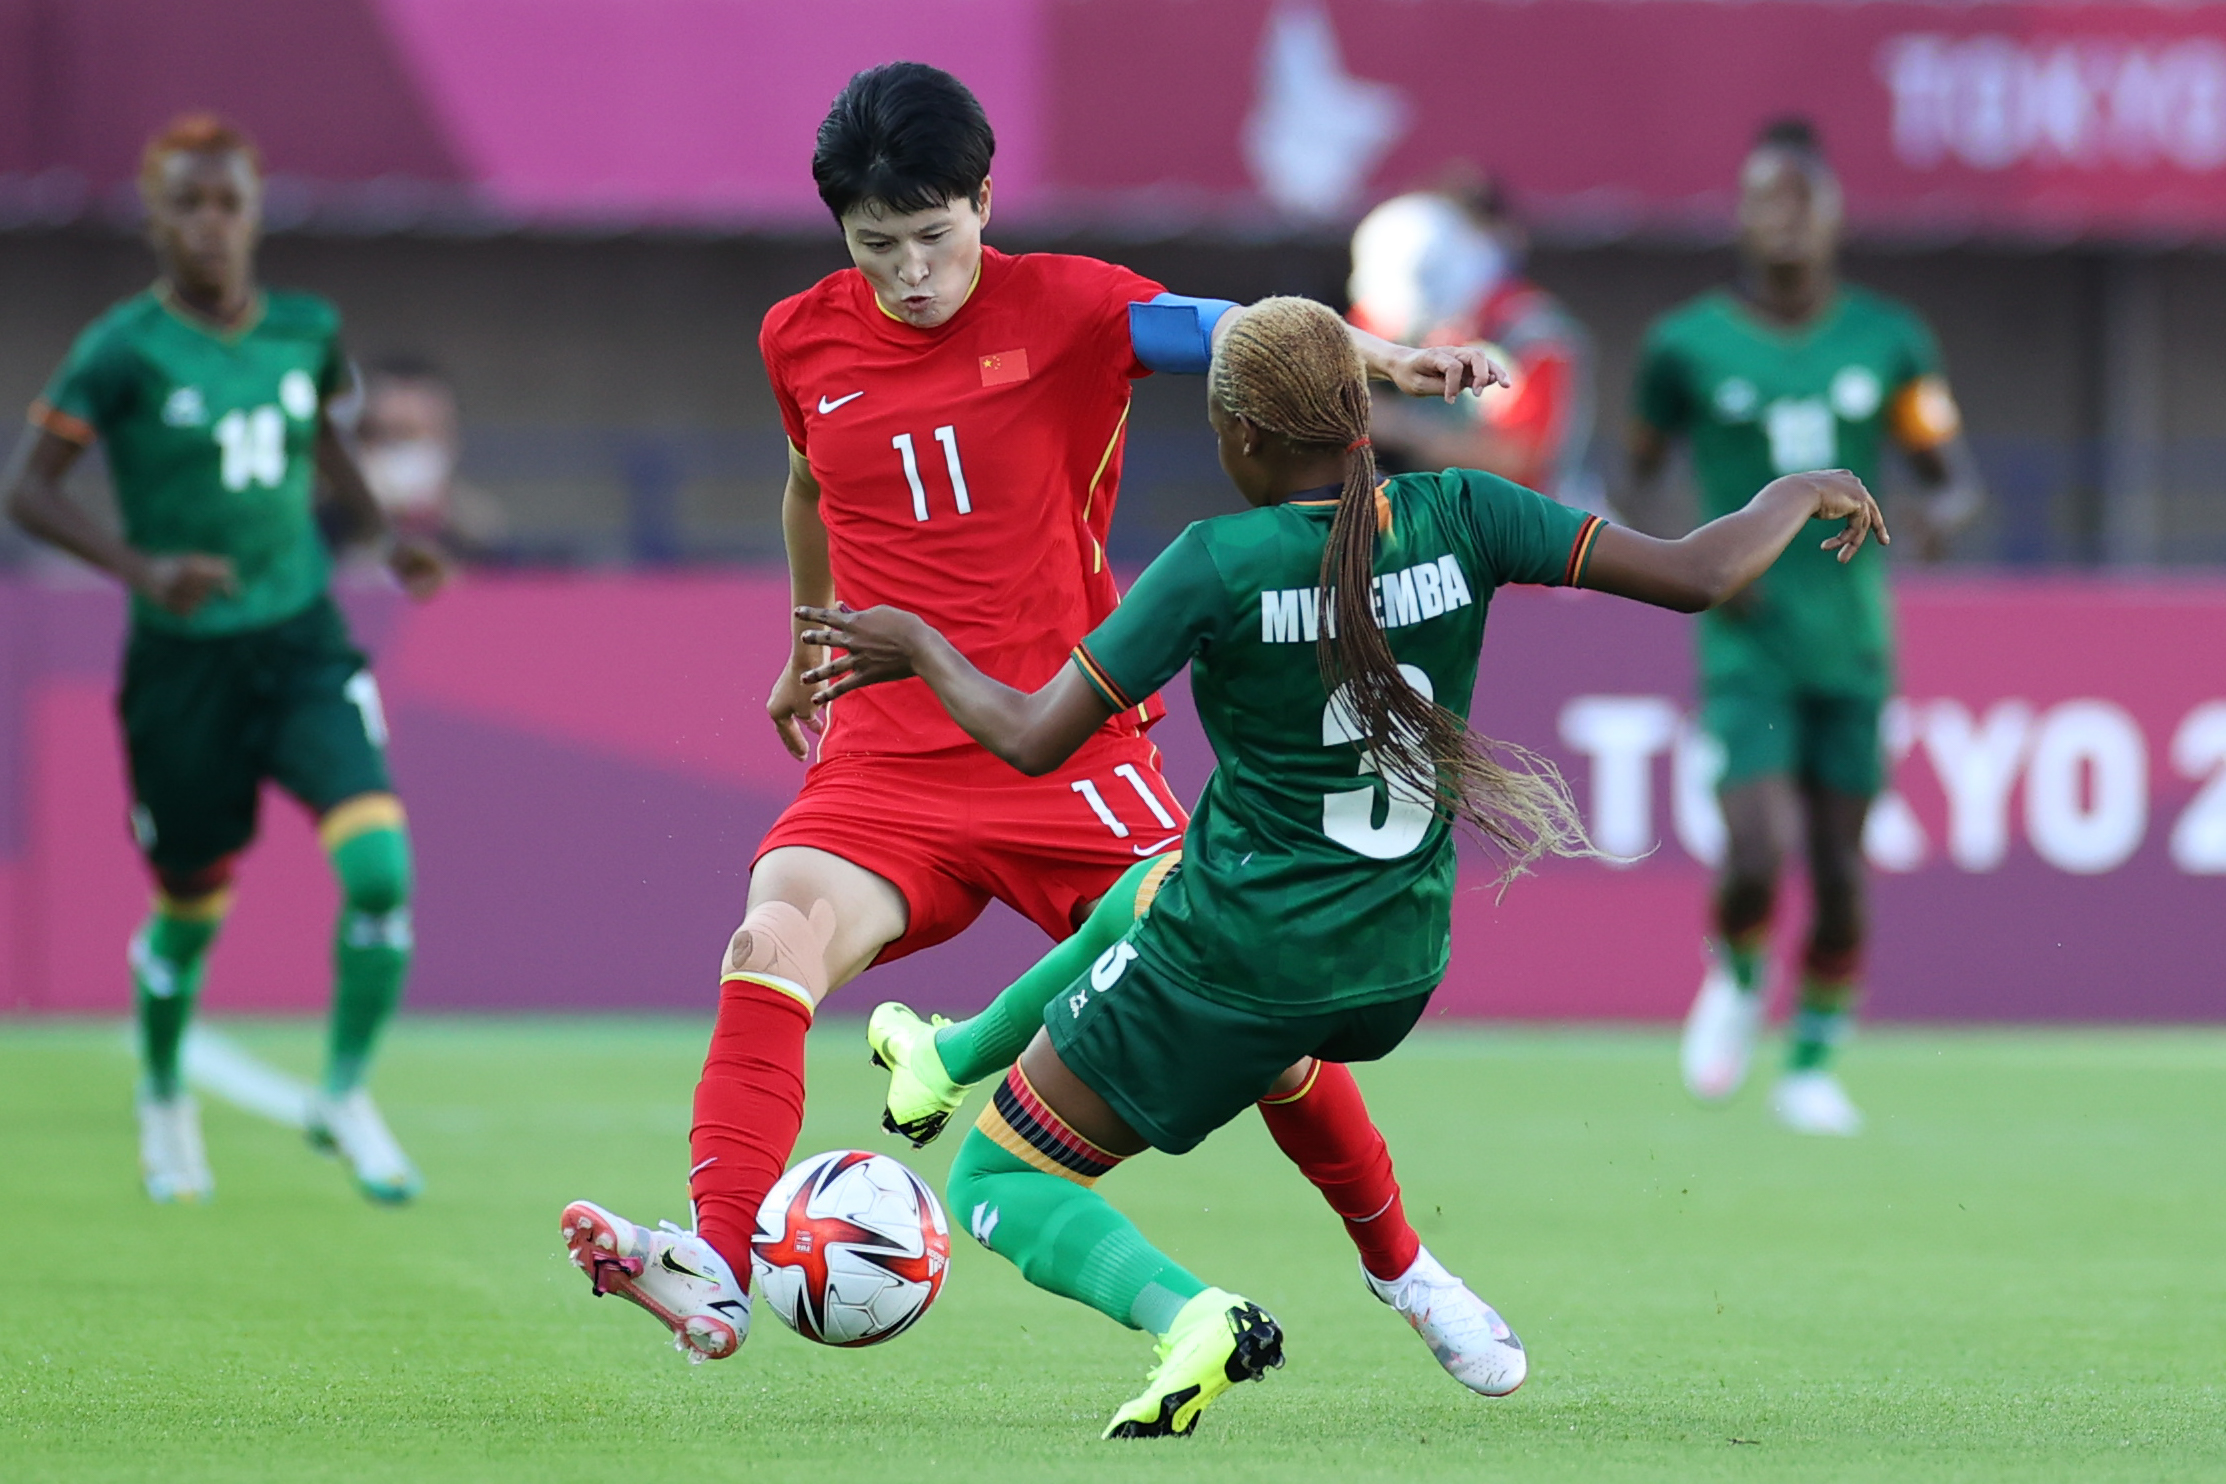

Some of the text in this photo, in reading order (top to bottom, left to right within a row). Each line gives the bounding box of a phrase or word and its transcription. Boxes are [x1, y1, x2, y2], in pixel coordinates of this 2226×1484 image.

[891, 425, 972, 522] 11
[1261, 554, 1472, 643] MWEMBA
[1071, 763, 1177, 838] 11
[1322, 663, 1436, 860] 3
